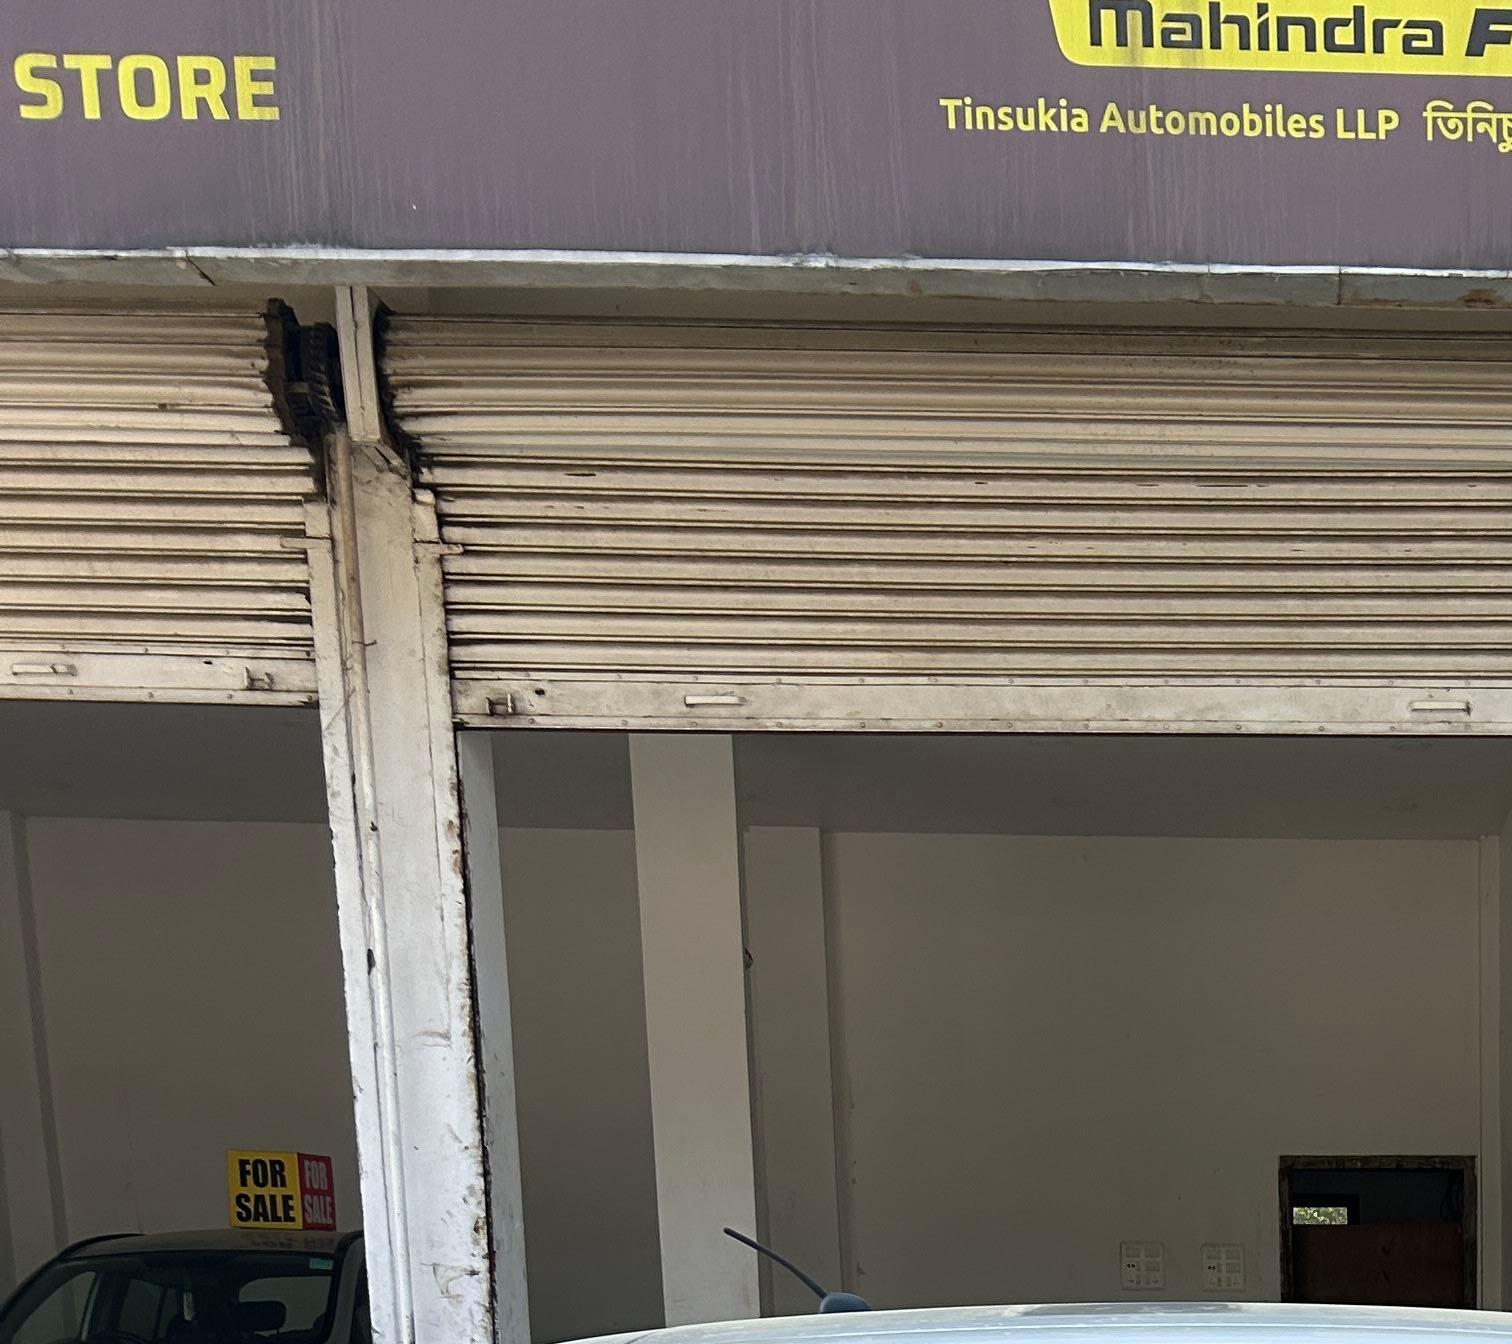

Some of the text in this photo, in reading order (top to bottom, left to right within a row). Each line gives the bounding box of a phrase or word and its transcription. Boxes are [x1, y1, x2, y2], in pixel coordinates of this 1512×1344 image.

[13, 53, 280, 121] STORE
[939, 97, 1400, 141] Tinsukia Automobiles LLP
[238, 1158, 287, 1188] FOR
[303, 1159, 329, 1190] FOR
[235, 1193, 296, 1223] SALE
[303, 1194, 334, 1224] SALE
